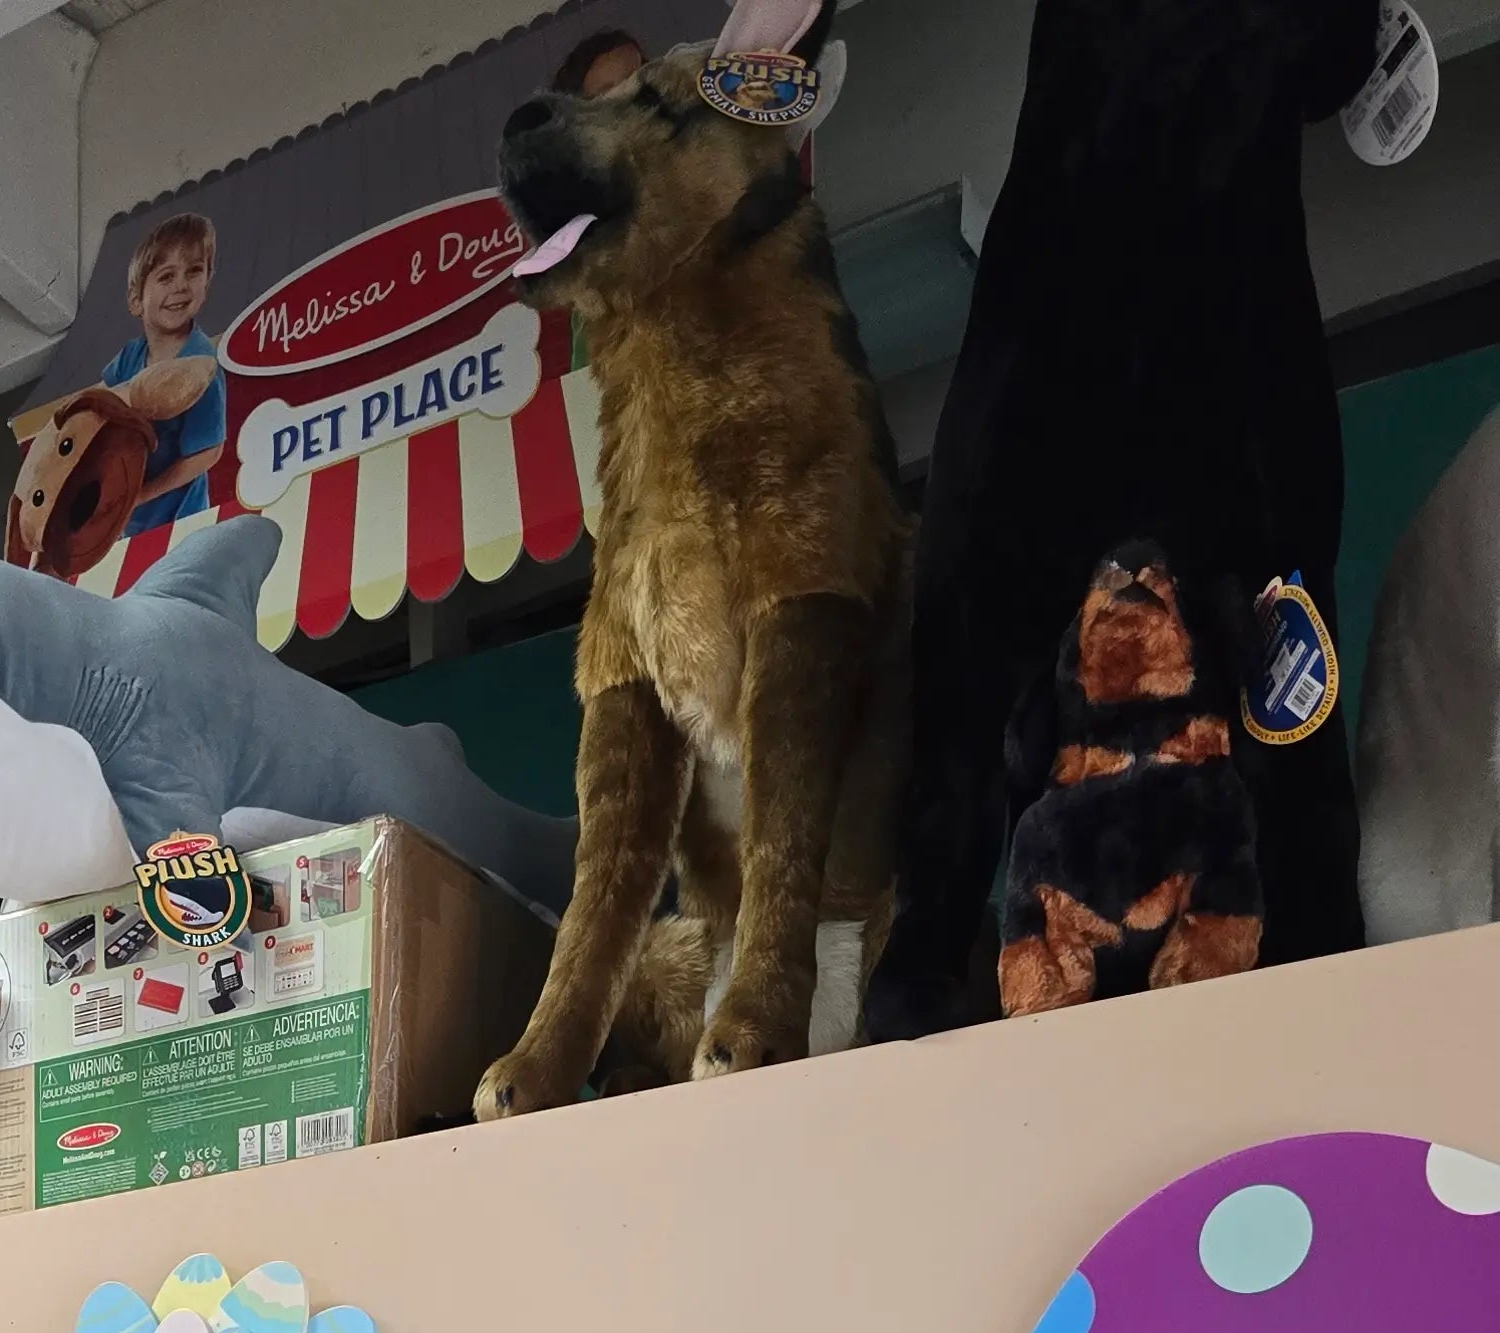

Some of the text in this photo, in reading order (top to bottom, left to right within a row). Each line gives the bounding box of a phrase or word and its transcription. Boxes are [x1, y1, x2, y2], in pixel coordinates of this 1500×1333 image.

[708, 59, 817, 87] PLUSH
[748, 92, 816, 122] SHEPHERD
[252, 222, 524, 353] Melissa & Doug
[272, 343, 506, 473] PET PLACE
[135, 847, 239, 888] PLUSH
[183, 926, 232, 947] SHARK
[272, 1001, 360, 1038] ADVERTENCIA:
[169, 1028, 232, 1060] ATTENTION
[68, 1054, 124, 1081] WARNING:
